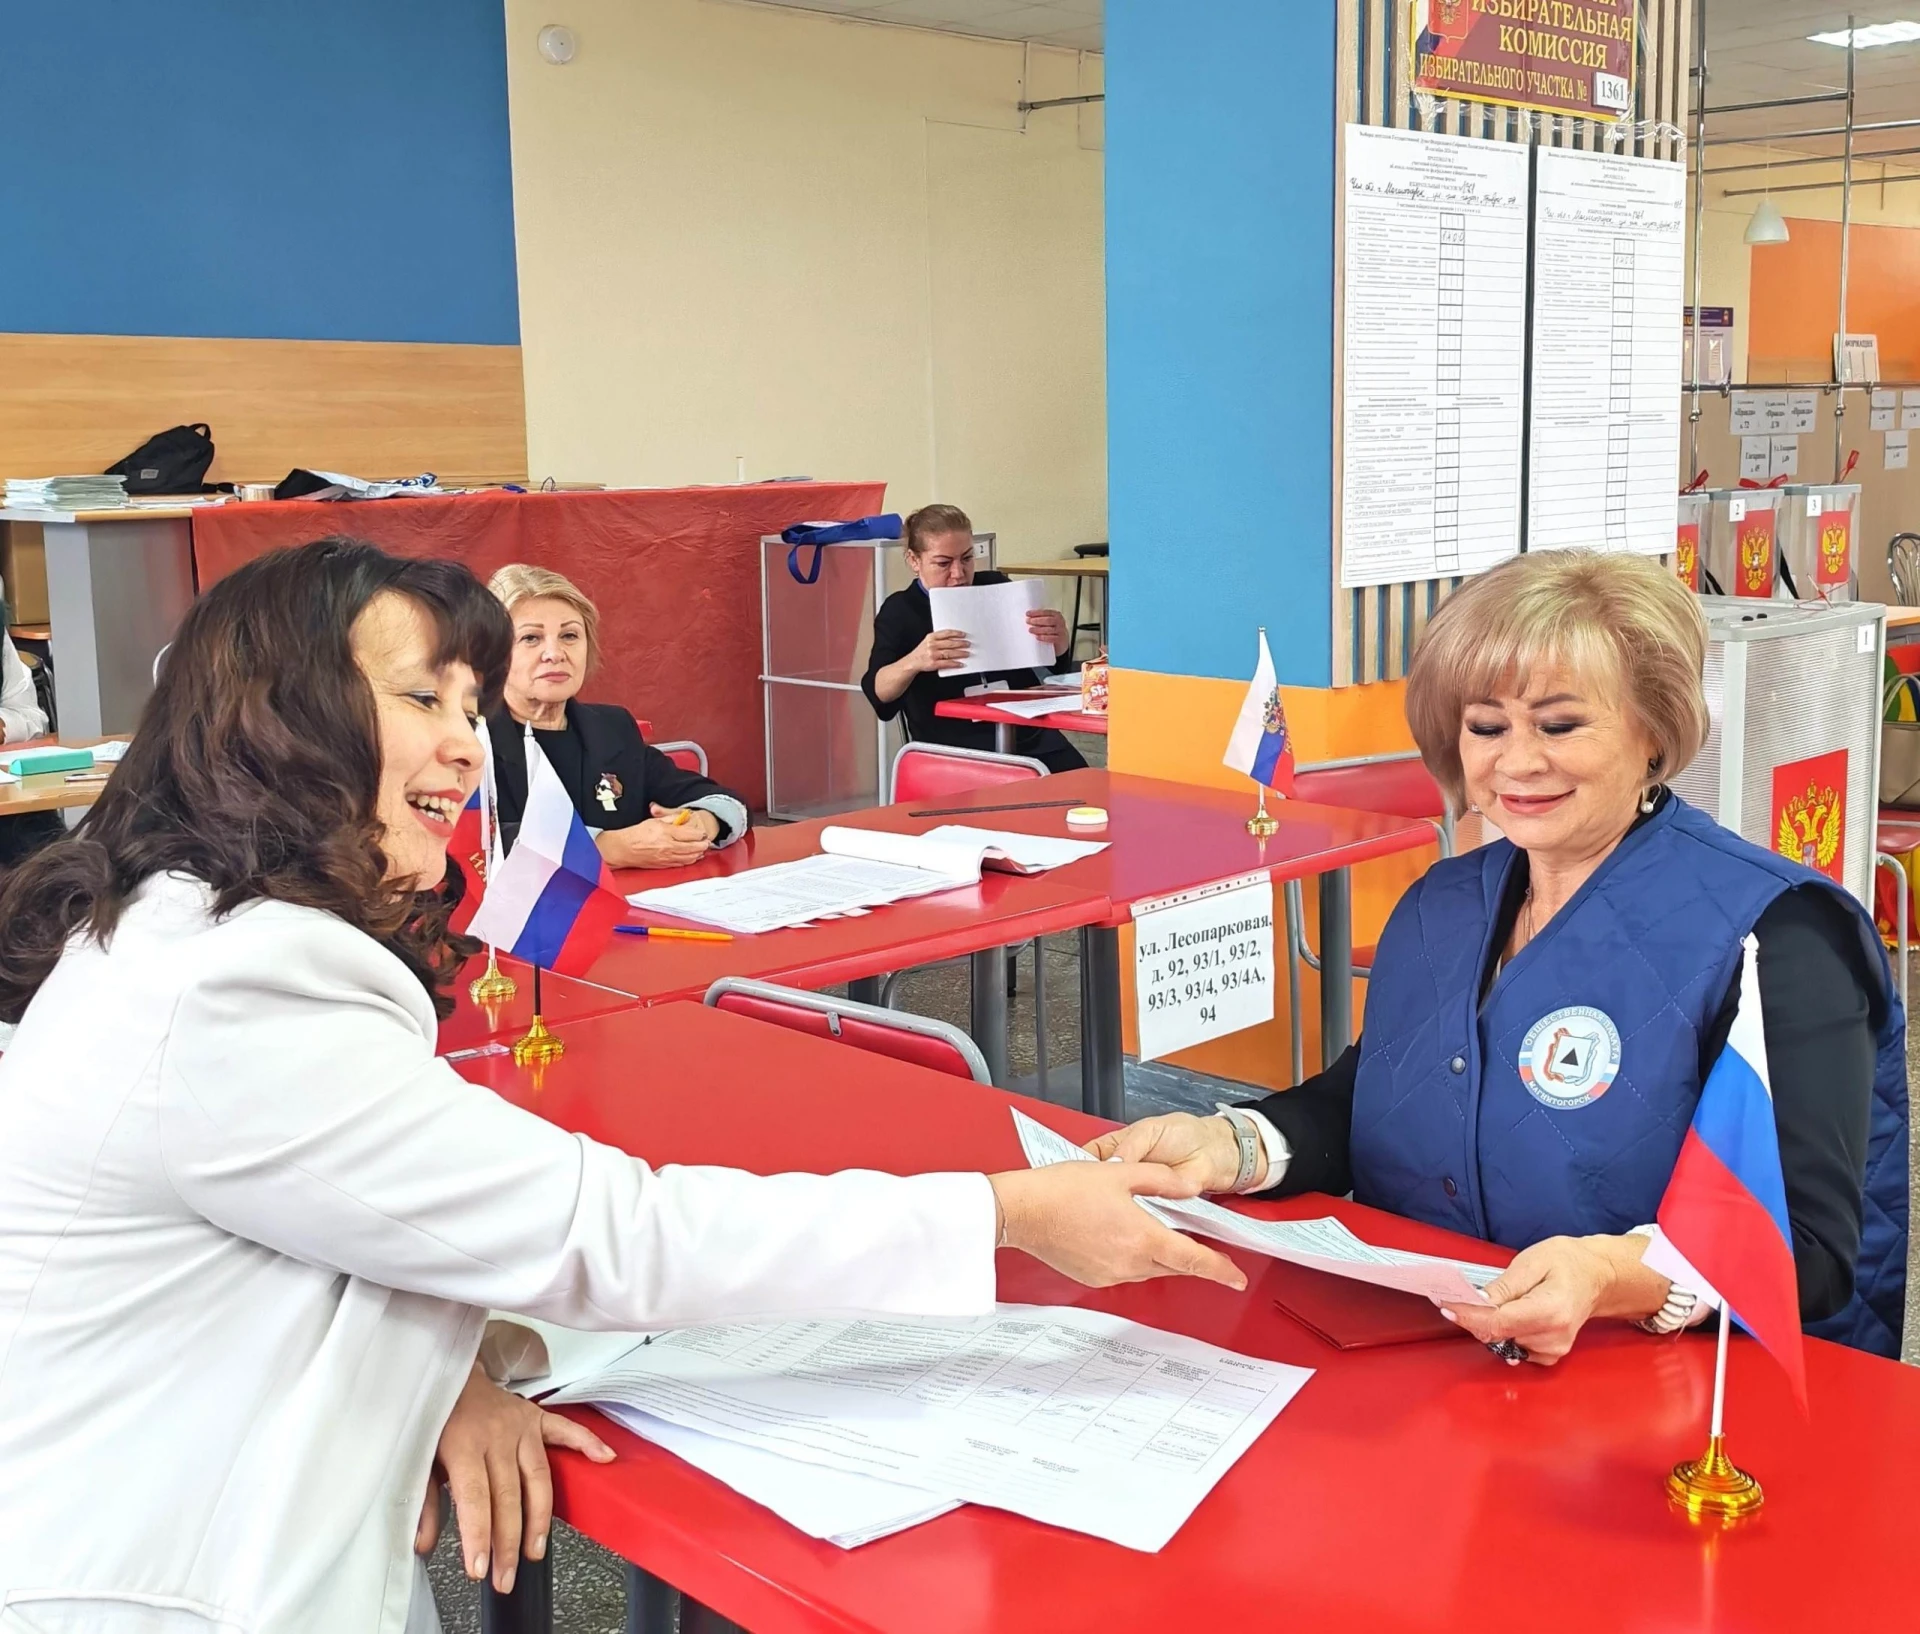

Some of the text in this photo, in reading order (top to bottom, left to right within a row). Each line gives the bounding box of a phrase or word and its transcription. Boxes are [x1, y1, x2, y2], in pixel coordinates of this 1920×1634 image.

[1471, 0, 1633, 42] ИЗБИРАТЕЛЬНАЯ
[1499, 24, 1608, 70] КОМИССИЯ
[1419, 53, 1625, 102] ИЗБИРАТЕЛЬНОГО УЧАСТКА № 1361
[1139, 914, 1273, 962] ул. Лесопарковая,
[1151, 939, 1262, 985] д. 92, 93/1, 93/2,
[1148, 987, 1182, 1013] 93/3,
[1185, 977, 1218, 1002] 93/4,
[1199, 1004, 1217, 1026] 94
[1528, 1080, 1591, 1107] МАГНИТОГОРСК
